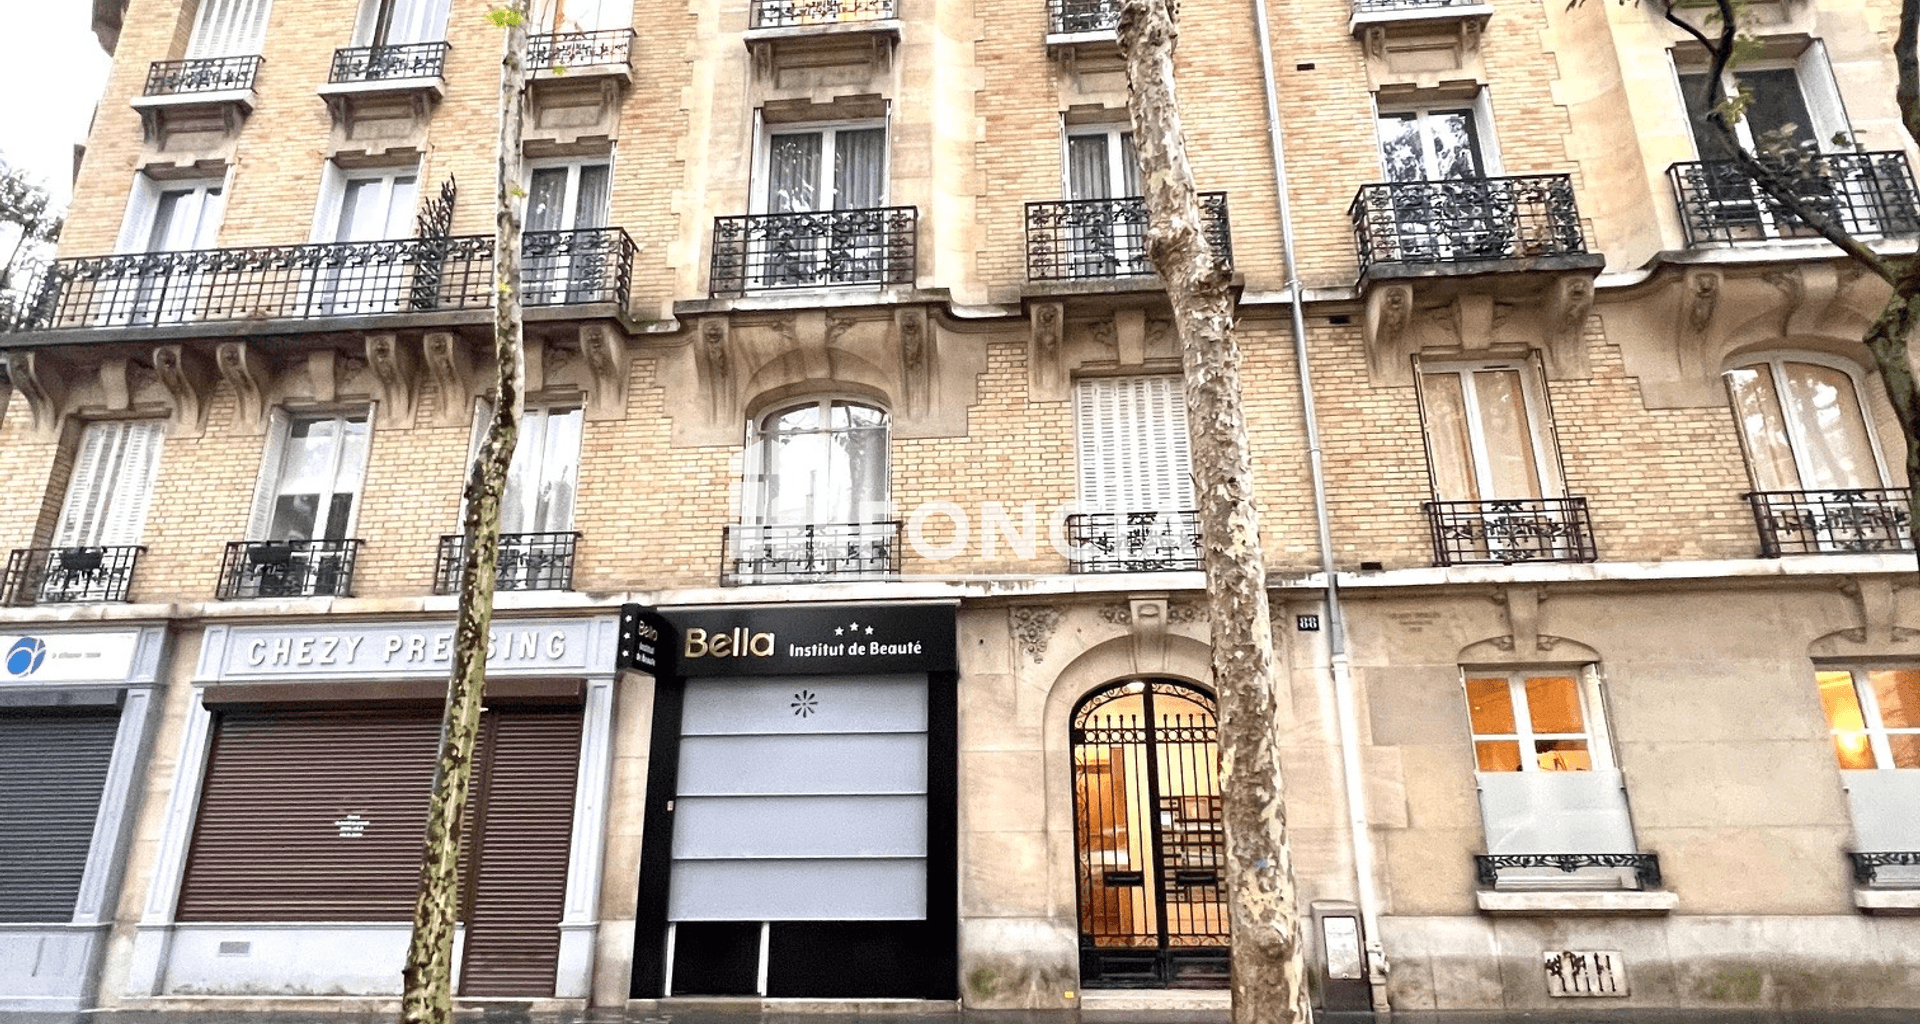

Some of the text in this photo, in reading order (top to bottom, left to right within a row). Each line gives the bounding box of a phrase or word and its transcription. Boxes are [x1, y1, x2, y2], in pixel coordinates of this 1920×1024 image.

[1299, 616, 1318, 629] 88
[248, 629, 567, 667] CHEZY PRESING
[684, 627, 775, 658] Bella
[789, 640, 923, 657] Institut de Beauté
